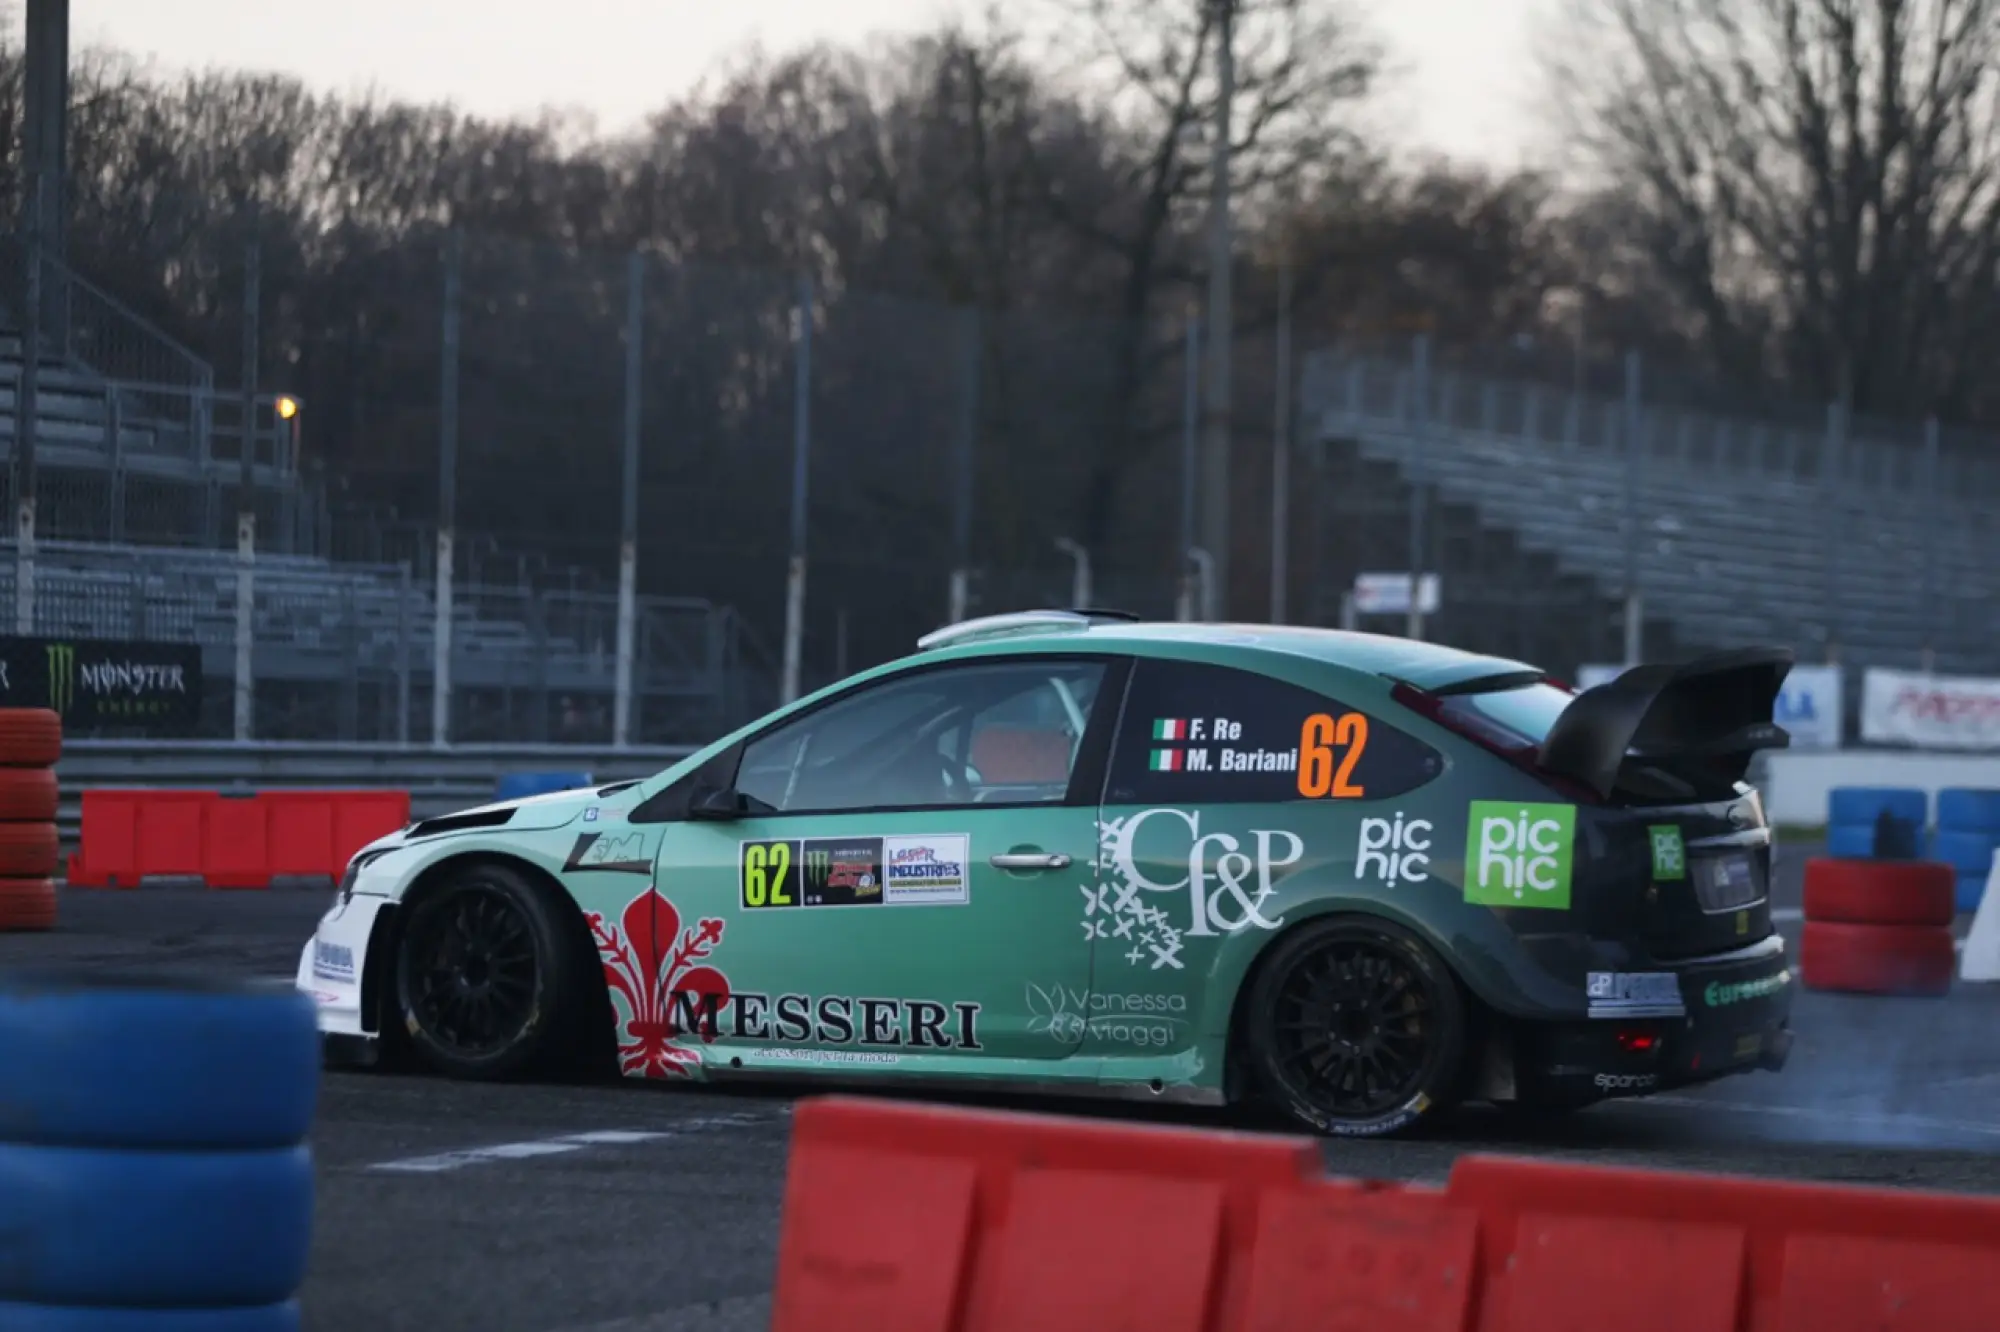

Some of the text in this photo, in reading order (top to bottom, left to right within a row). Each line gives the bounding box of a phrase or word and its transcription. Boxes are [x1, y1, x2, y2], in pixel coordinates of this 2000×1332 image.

[80, 658, 186, 695] MONSTER
[1189, 718, 1242, 740] F. Re
[1186, 748, 1298, 771] M. Bariani
[1297, 711, 1369, 798] 62
[1358, 810, 1433, 852] pic
[1481, 810, 1561, 854] pic
[888, 846, 937, 864] LASER
[888, 862, 960, 878] INDUSTRIES
[744, 842, 792, 907] 62
[1068, 988, 1187, 1011] Vanessa
[669, 990, 984, 1050] MESSERI
